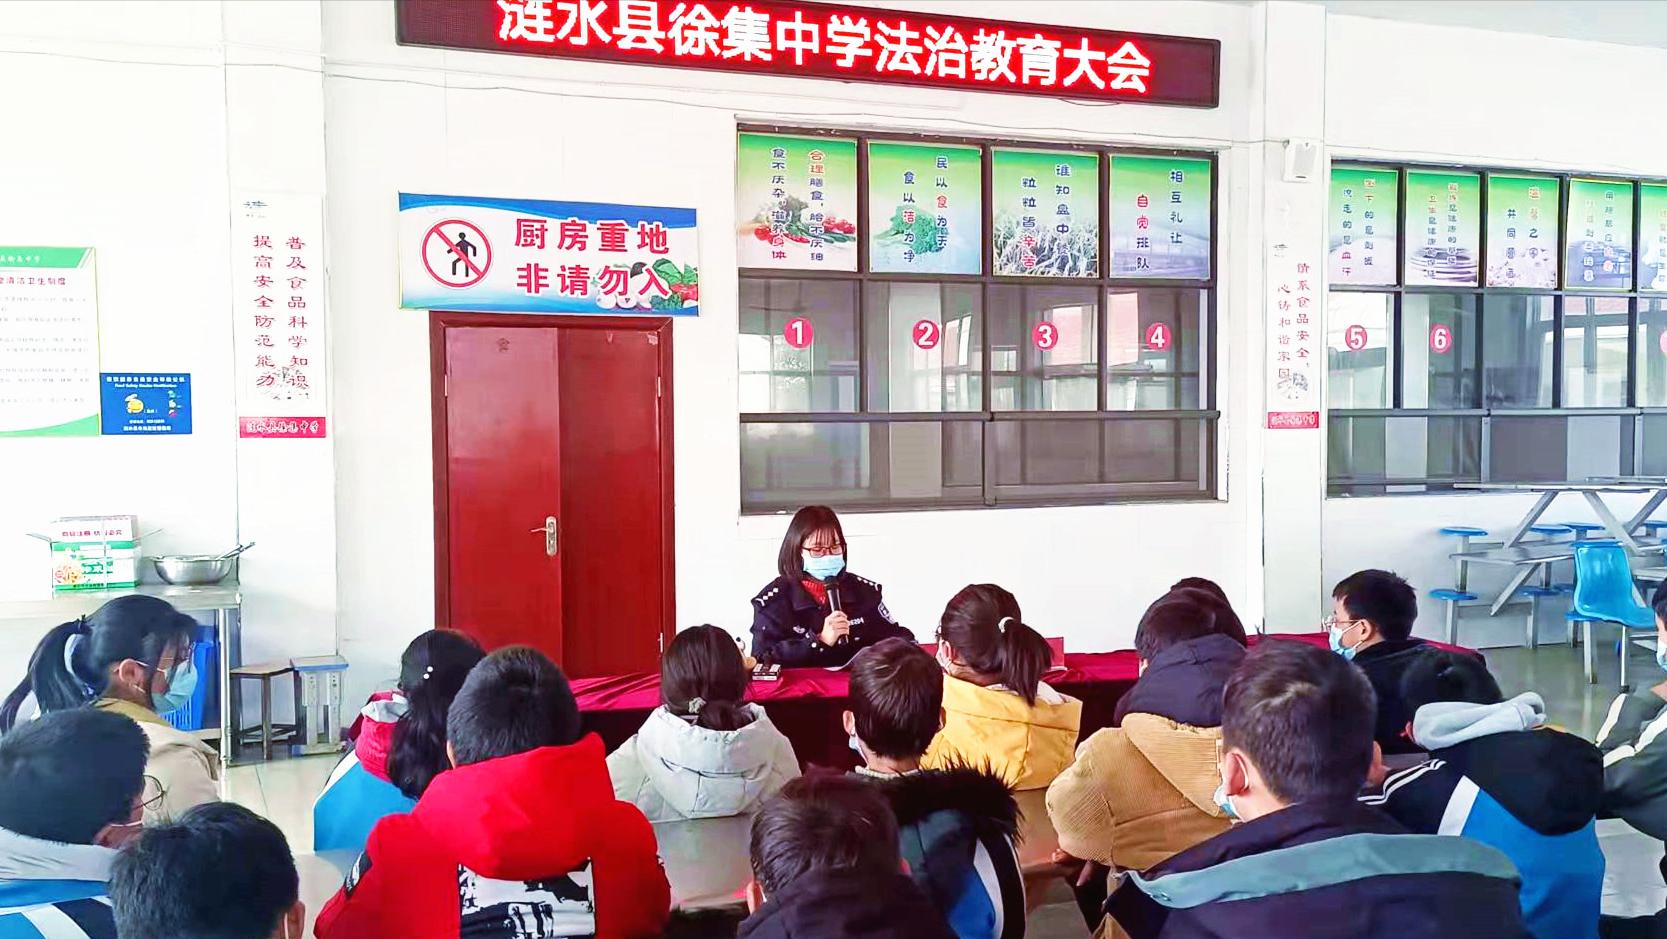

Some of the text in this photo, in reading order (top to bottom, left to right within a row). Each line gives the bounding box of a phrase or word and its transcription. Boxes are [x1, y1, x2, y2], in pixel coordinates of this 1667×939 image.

[498, 0, 1152, 93] 涟水县徐集中学法治教育大会
[936, 157, 949, 248] 民以食为天
[1169, 170, 1184, 245] 相互礼让
[515, 218, 670, 254] 厨房重地
[1022, 178, 1037, 268] 粒粒皆辛苦
[1136, 193, 1150, 270] 自觉排队
[516, 262, 671, 297] 非请勿入
[253, 234, 275, 388] 提高安全防范能力
[285, 235, 310, 390] 普及食品科学知识
[791, 321, 803, 345] 1
[918, 322, 934, 346] 2
[1038, 325, 1053, 348] 3
[1150, 326, 1165, 348] 4
[1350, 327, 1363, 350] 5
[1434, 328, 1447, 350] 6
